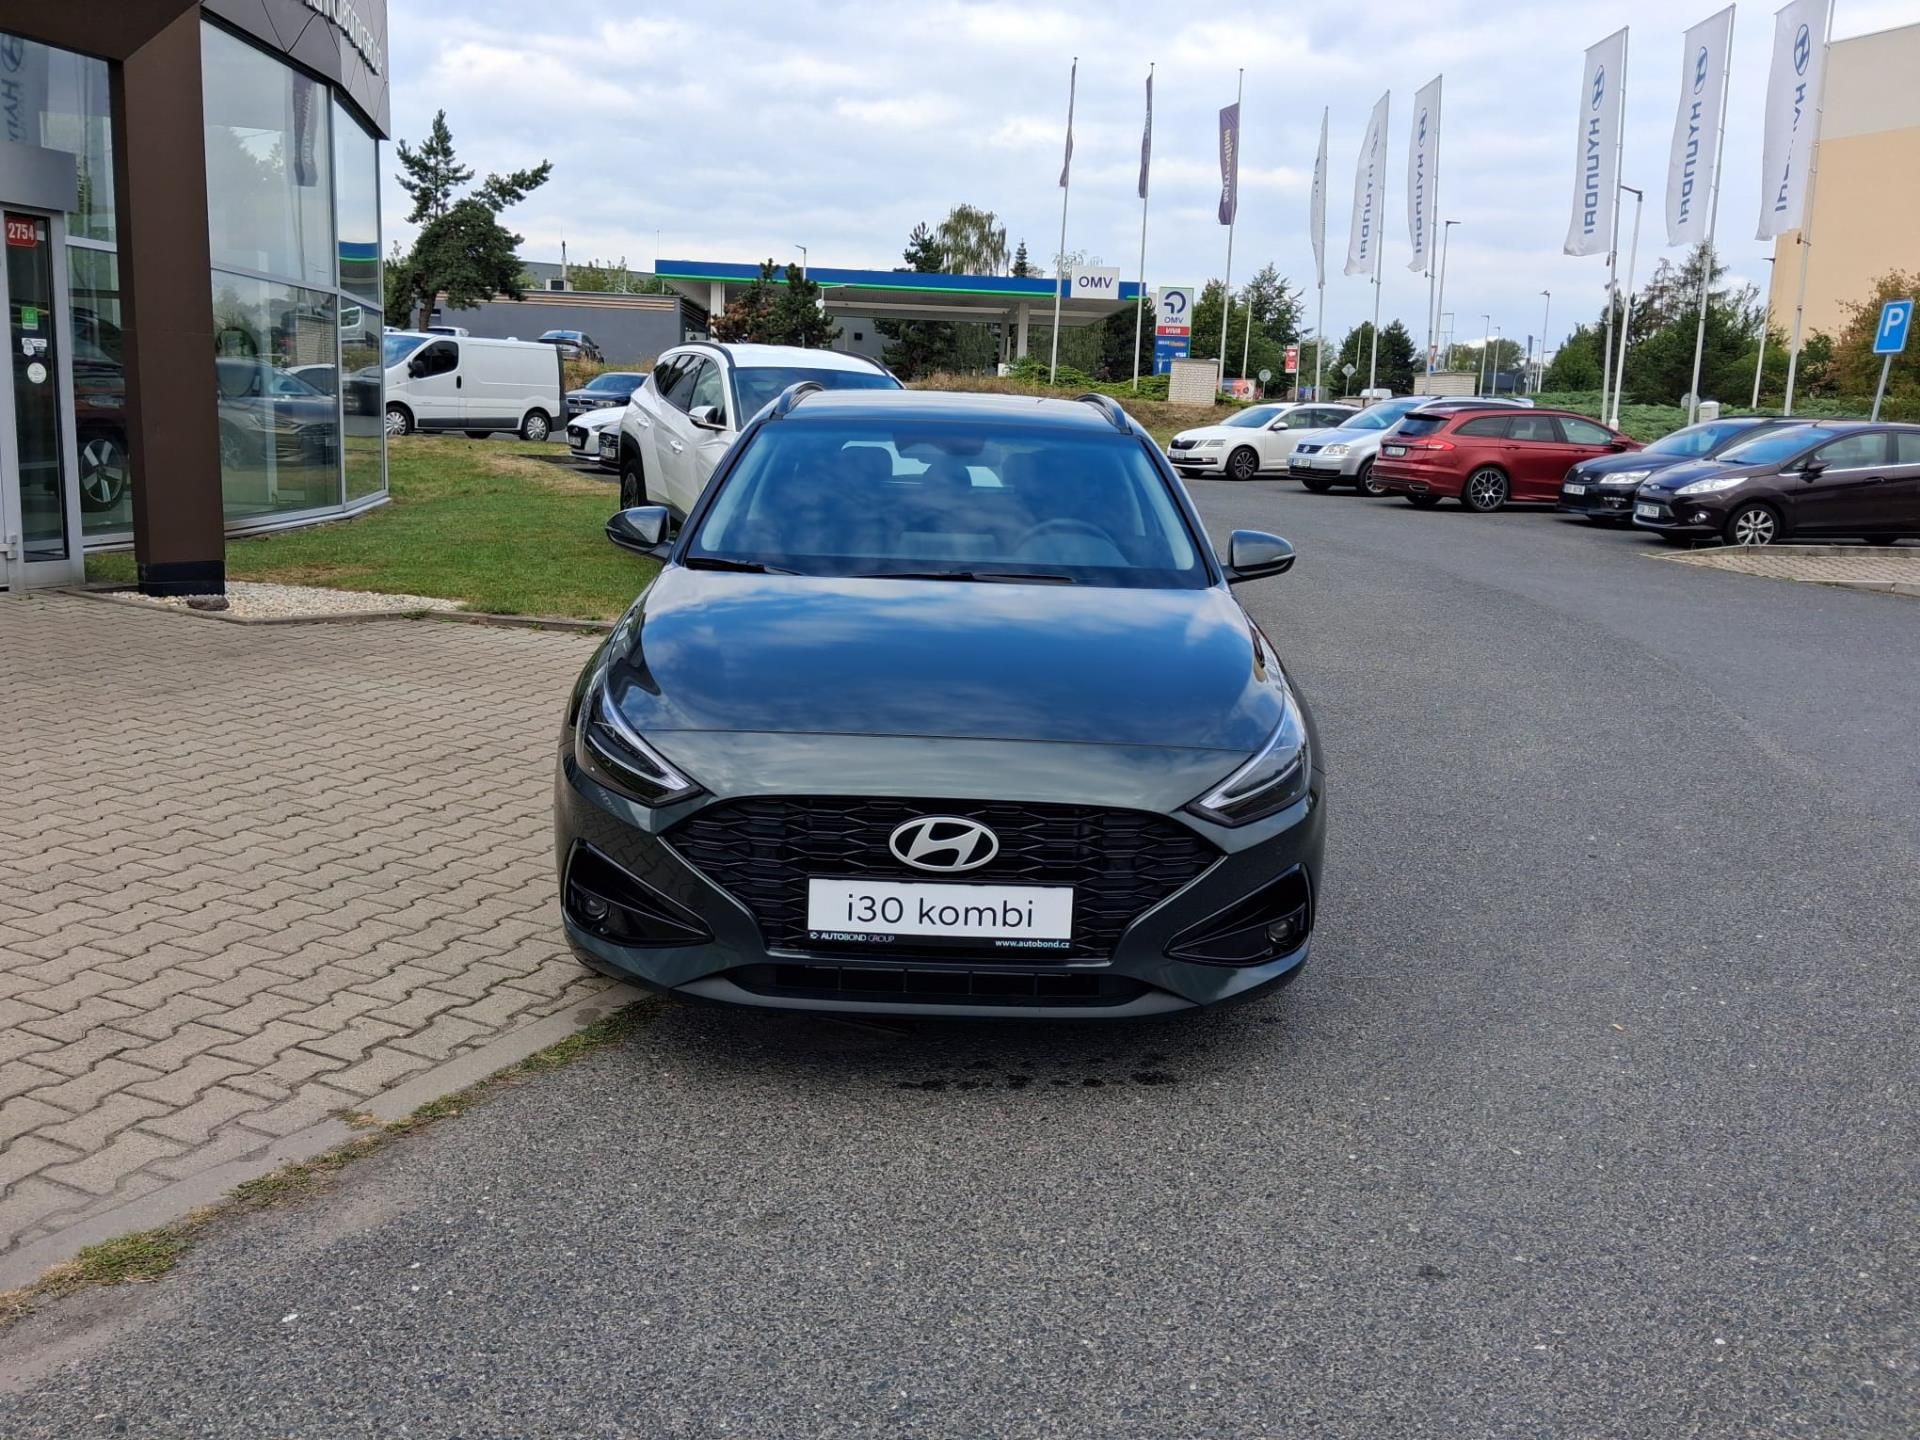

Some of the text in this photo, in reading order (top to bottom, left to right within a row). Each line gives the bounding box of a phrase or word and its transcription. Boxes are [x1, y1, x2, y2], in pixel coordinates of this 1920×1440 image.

[8, 222, 35, 241] 2754
[1078, 275, 1113, 289] OMV
[1164, 316, 1184, 324] OMV
[1883, 307, 1905, 337] P
[847, 894, 1033, 928] i30 kombi
[820, 931, 867, 942] AUTOBOND
[995, 939, 1070, 949] www.autobond.cz
